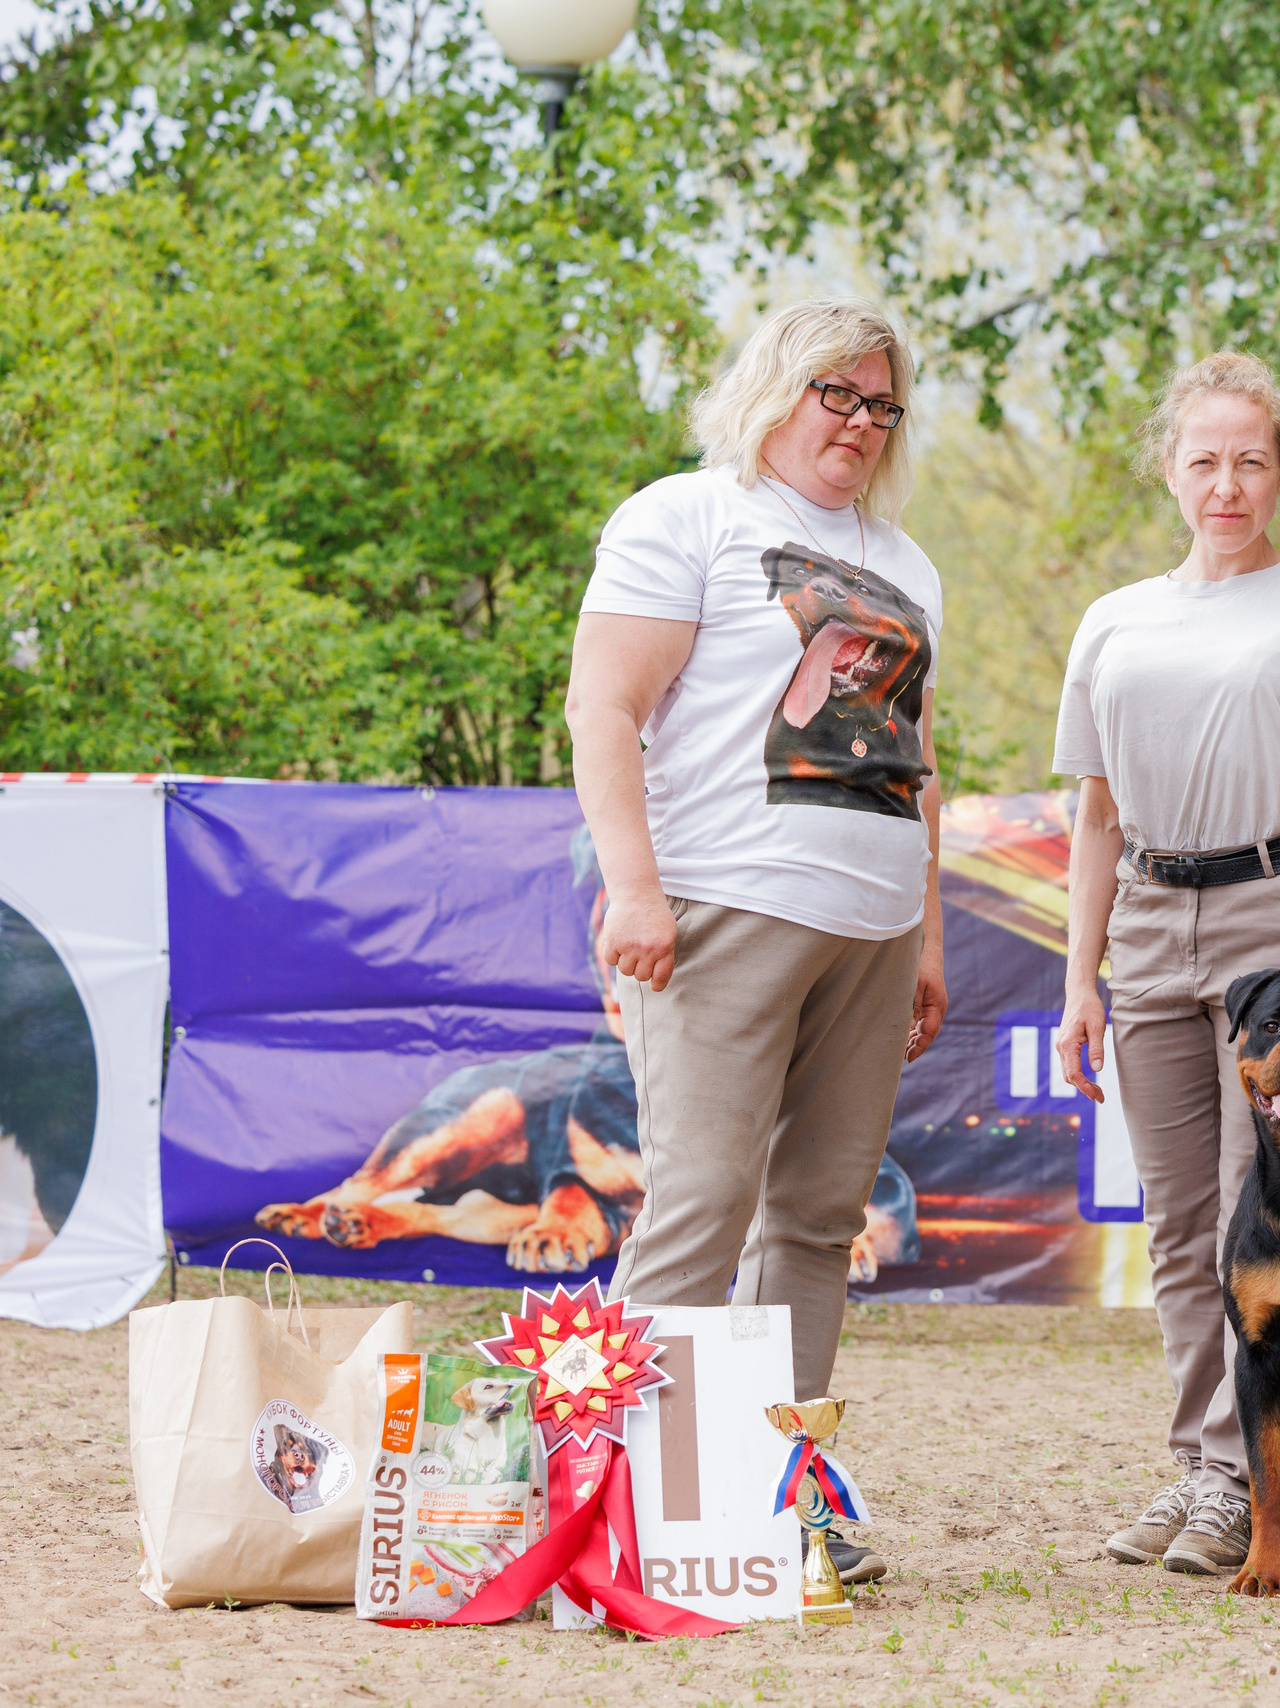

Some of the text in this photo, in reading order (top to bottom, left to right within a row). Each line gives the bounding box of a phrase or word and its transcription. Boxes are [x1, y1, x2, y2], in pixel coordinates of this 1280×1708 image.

[387, 1418, 411, 1433] ADULT
[650, 1335, 701, 1521] 1
[289, 1408, 345, 1457] ФОРТУНЫ
[419, 1464, 446, 1476] 44%
[422, 1490, 468, 1501] ЯГНЕНОК
[422, 1499, 468, 1508] С РИСОМ
[367, 1609, 399, 1617] PREMIUM
